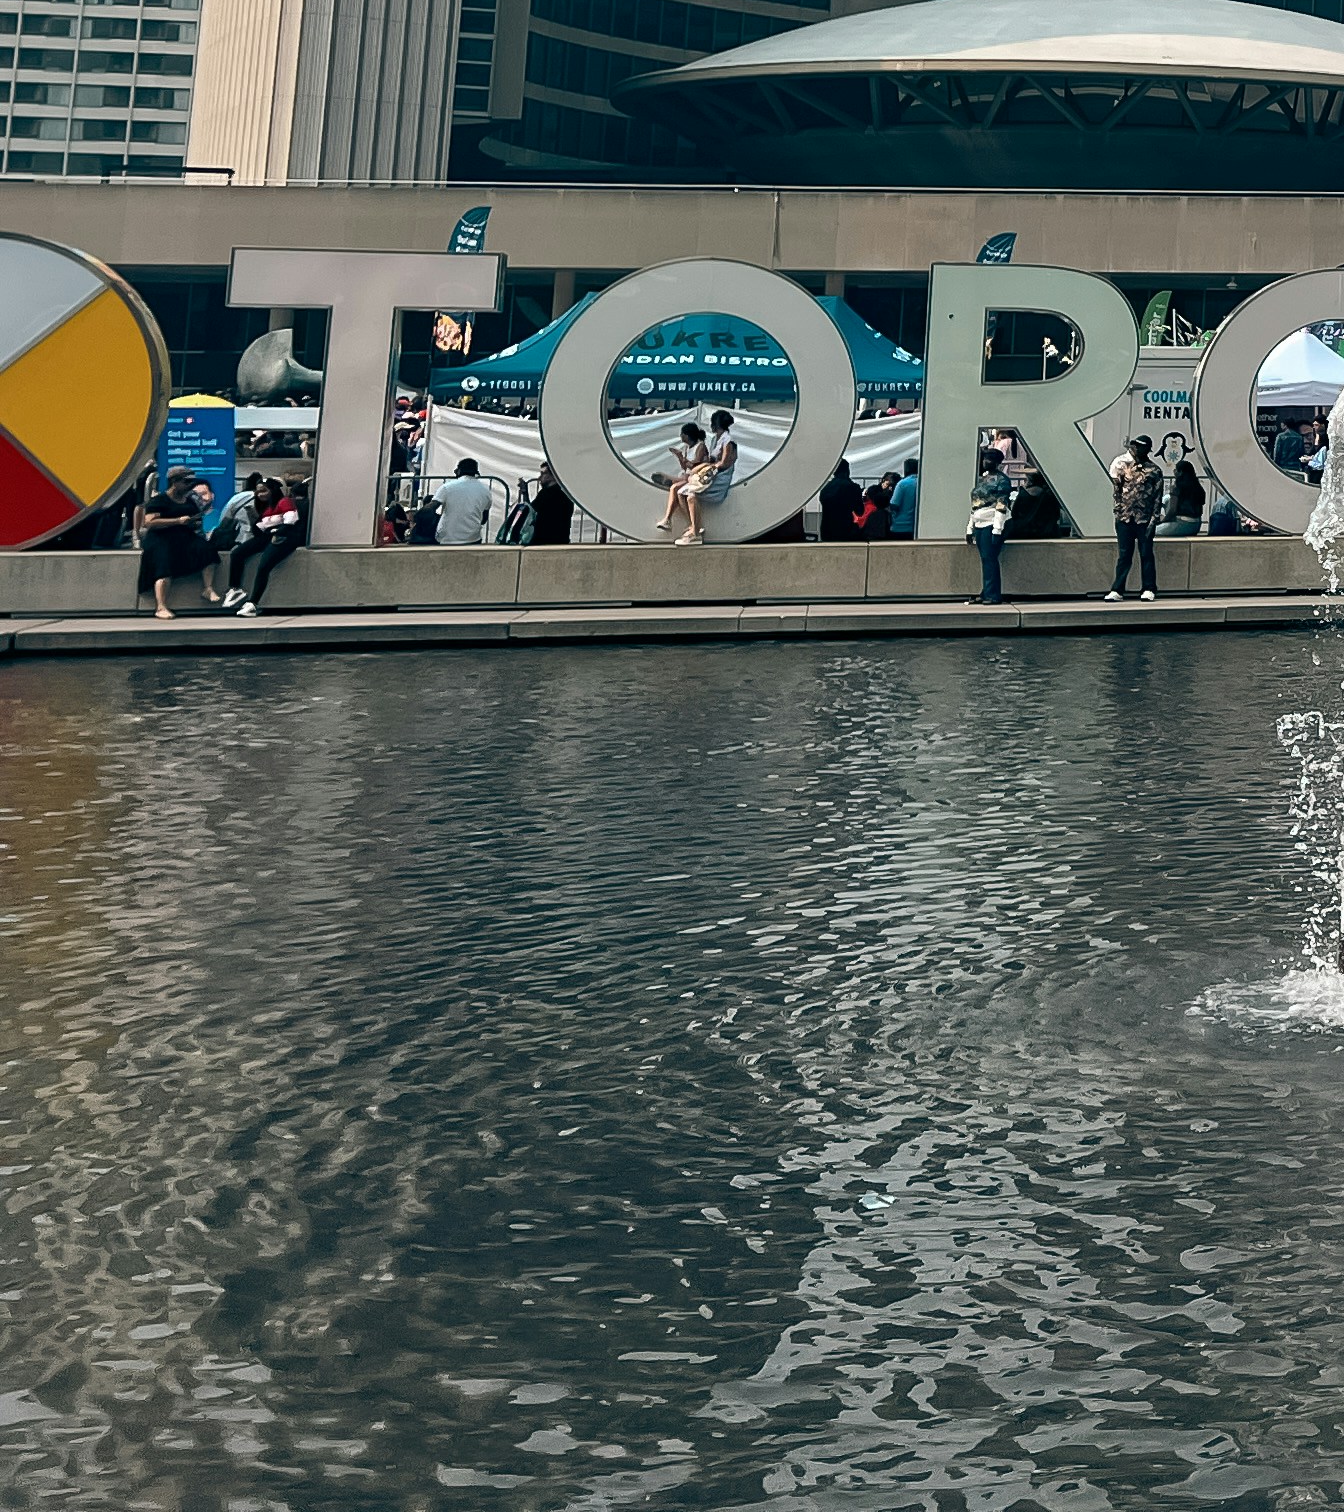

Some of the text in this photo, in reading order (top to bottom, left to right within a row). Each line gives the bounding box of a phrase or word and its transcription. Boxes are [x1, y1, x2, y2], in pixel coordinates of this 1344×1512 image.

[636, 331, 770, 351] UKRE
[620, 354, 788, 367] NDIAN BISTRO
[1143, 390, 1191, 403] COOLM
[1143, 406, 1191, 419] RENTA
